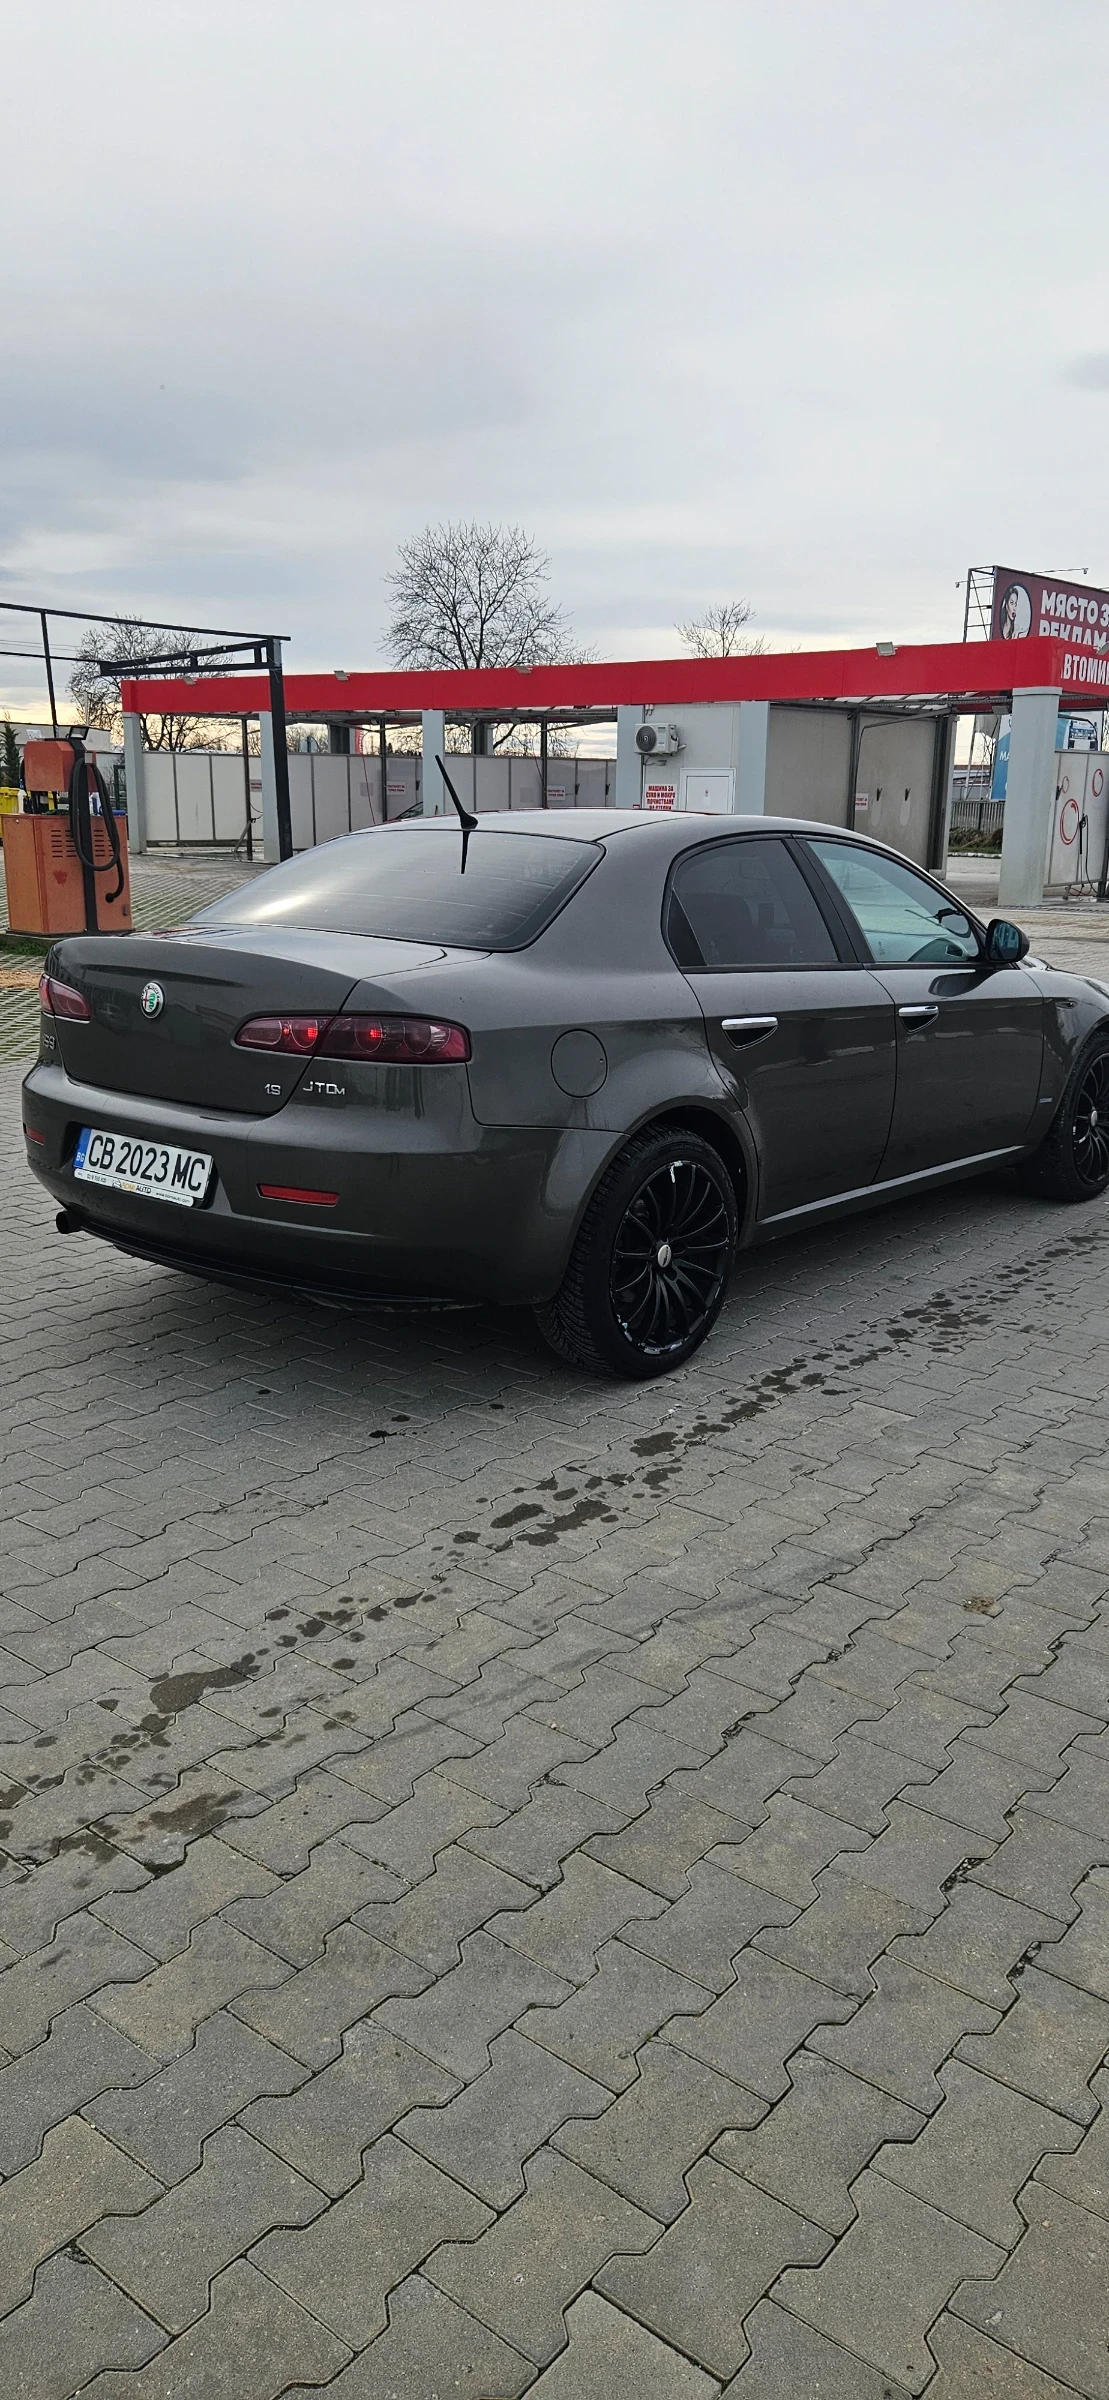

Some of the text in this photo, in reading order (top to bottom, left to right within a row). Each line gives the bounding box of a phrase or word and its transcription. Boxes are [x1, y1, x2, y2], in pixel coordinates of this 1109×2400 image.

[1040, 589, 1109, 627] МЯСТО З
[1060, 653, 1109, 686] ВТОМИ
[75, 1151, 86, 1163] BG
[88, 1134, 206, 1192] CB 2023 MC
